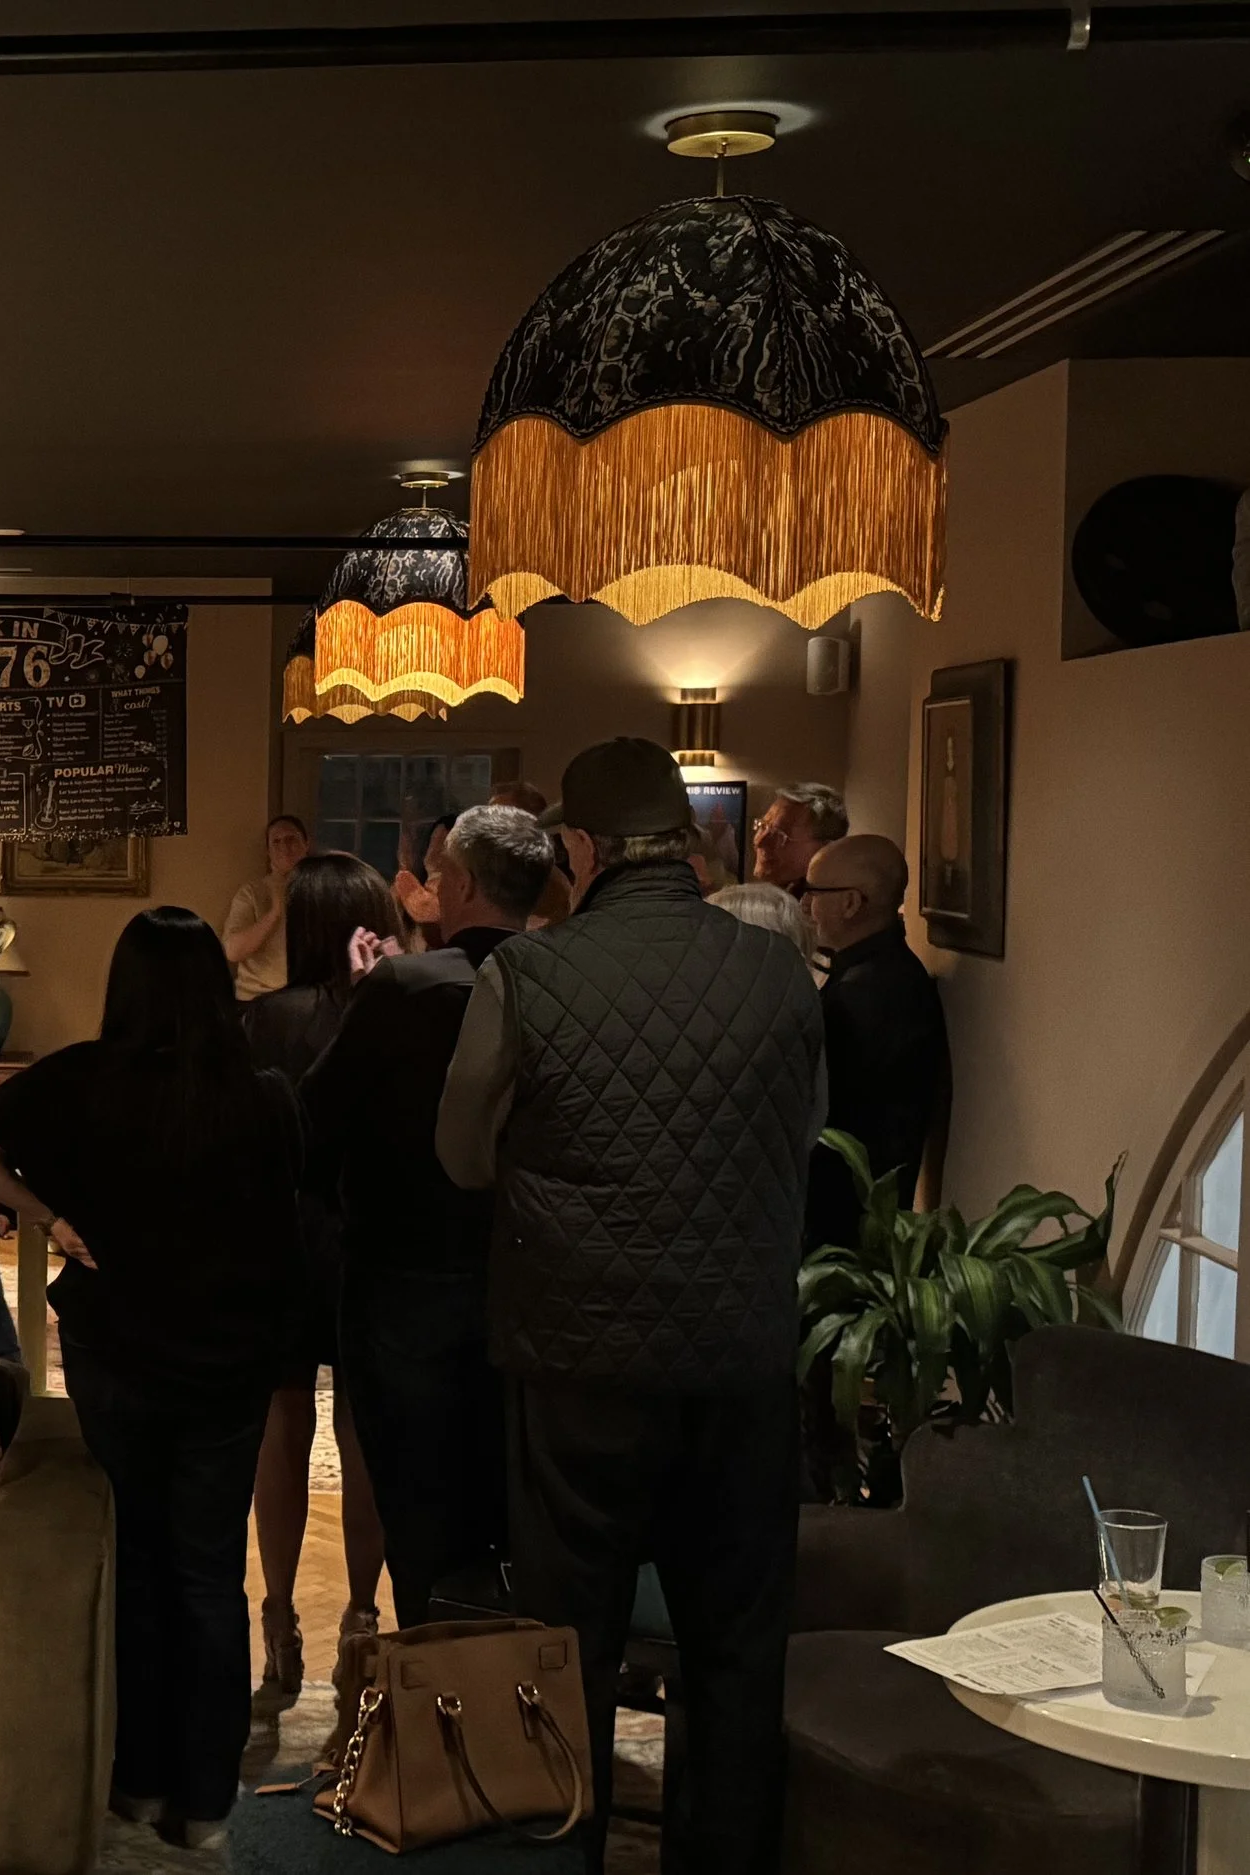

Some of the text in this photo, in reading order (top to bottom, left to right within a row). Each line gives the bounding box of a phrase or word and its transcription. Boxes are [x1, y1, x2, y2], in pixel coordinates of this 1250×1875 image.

[12, 620, 40, 639] IN
[111, 689, 132, 697] WHAT
[46, 696, 65, 708] TV
[54, 763, 150, 778] POPULAR Music
[703, 786, 741, 795] REVIEW
